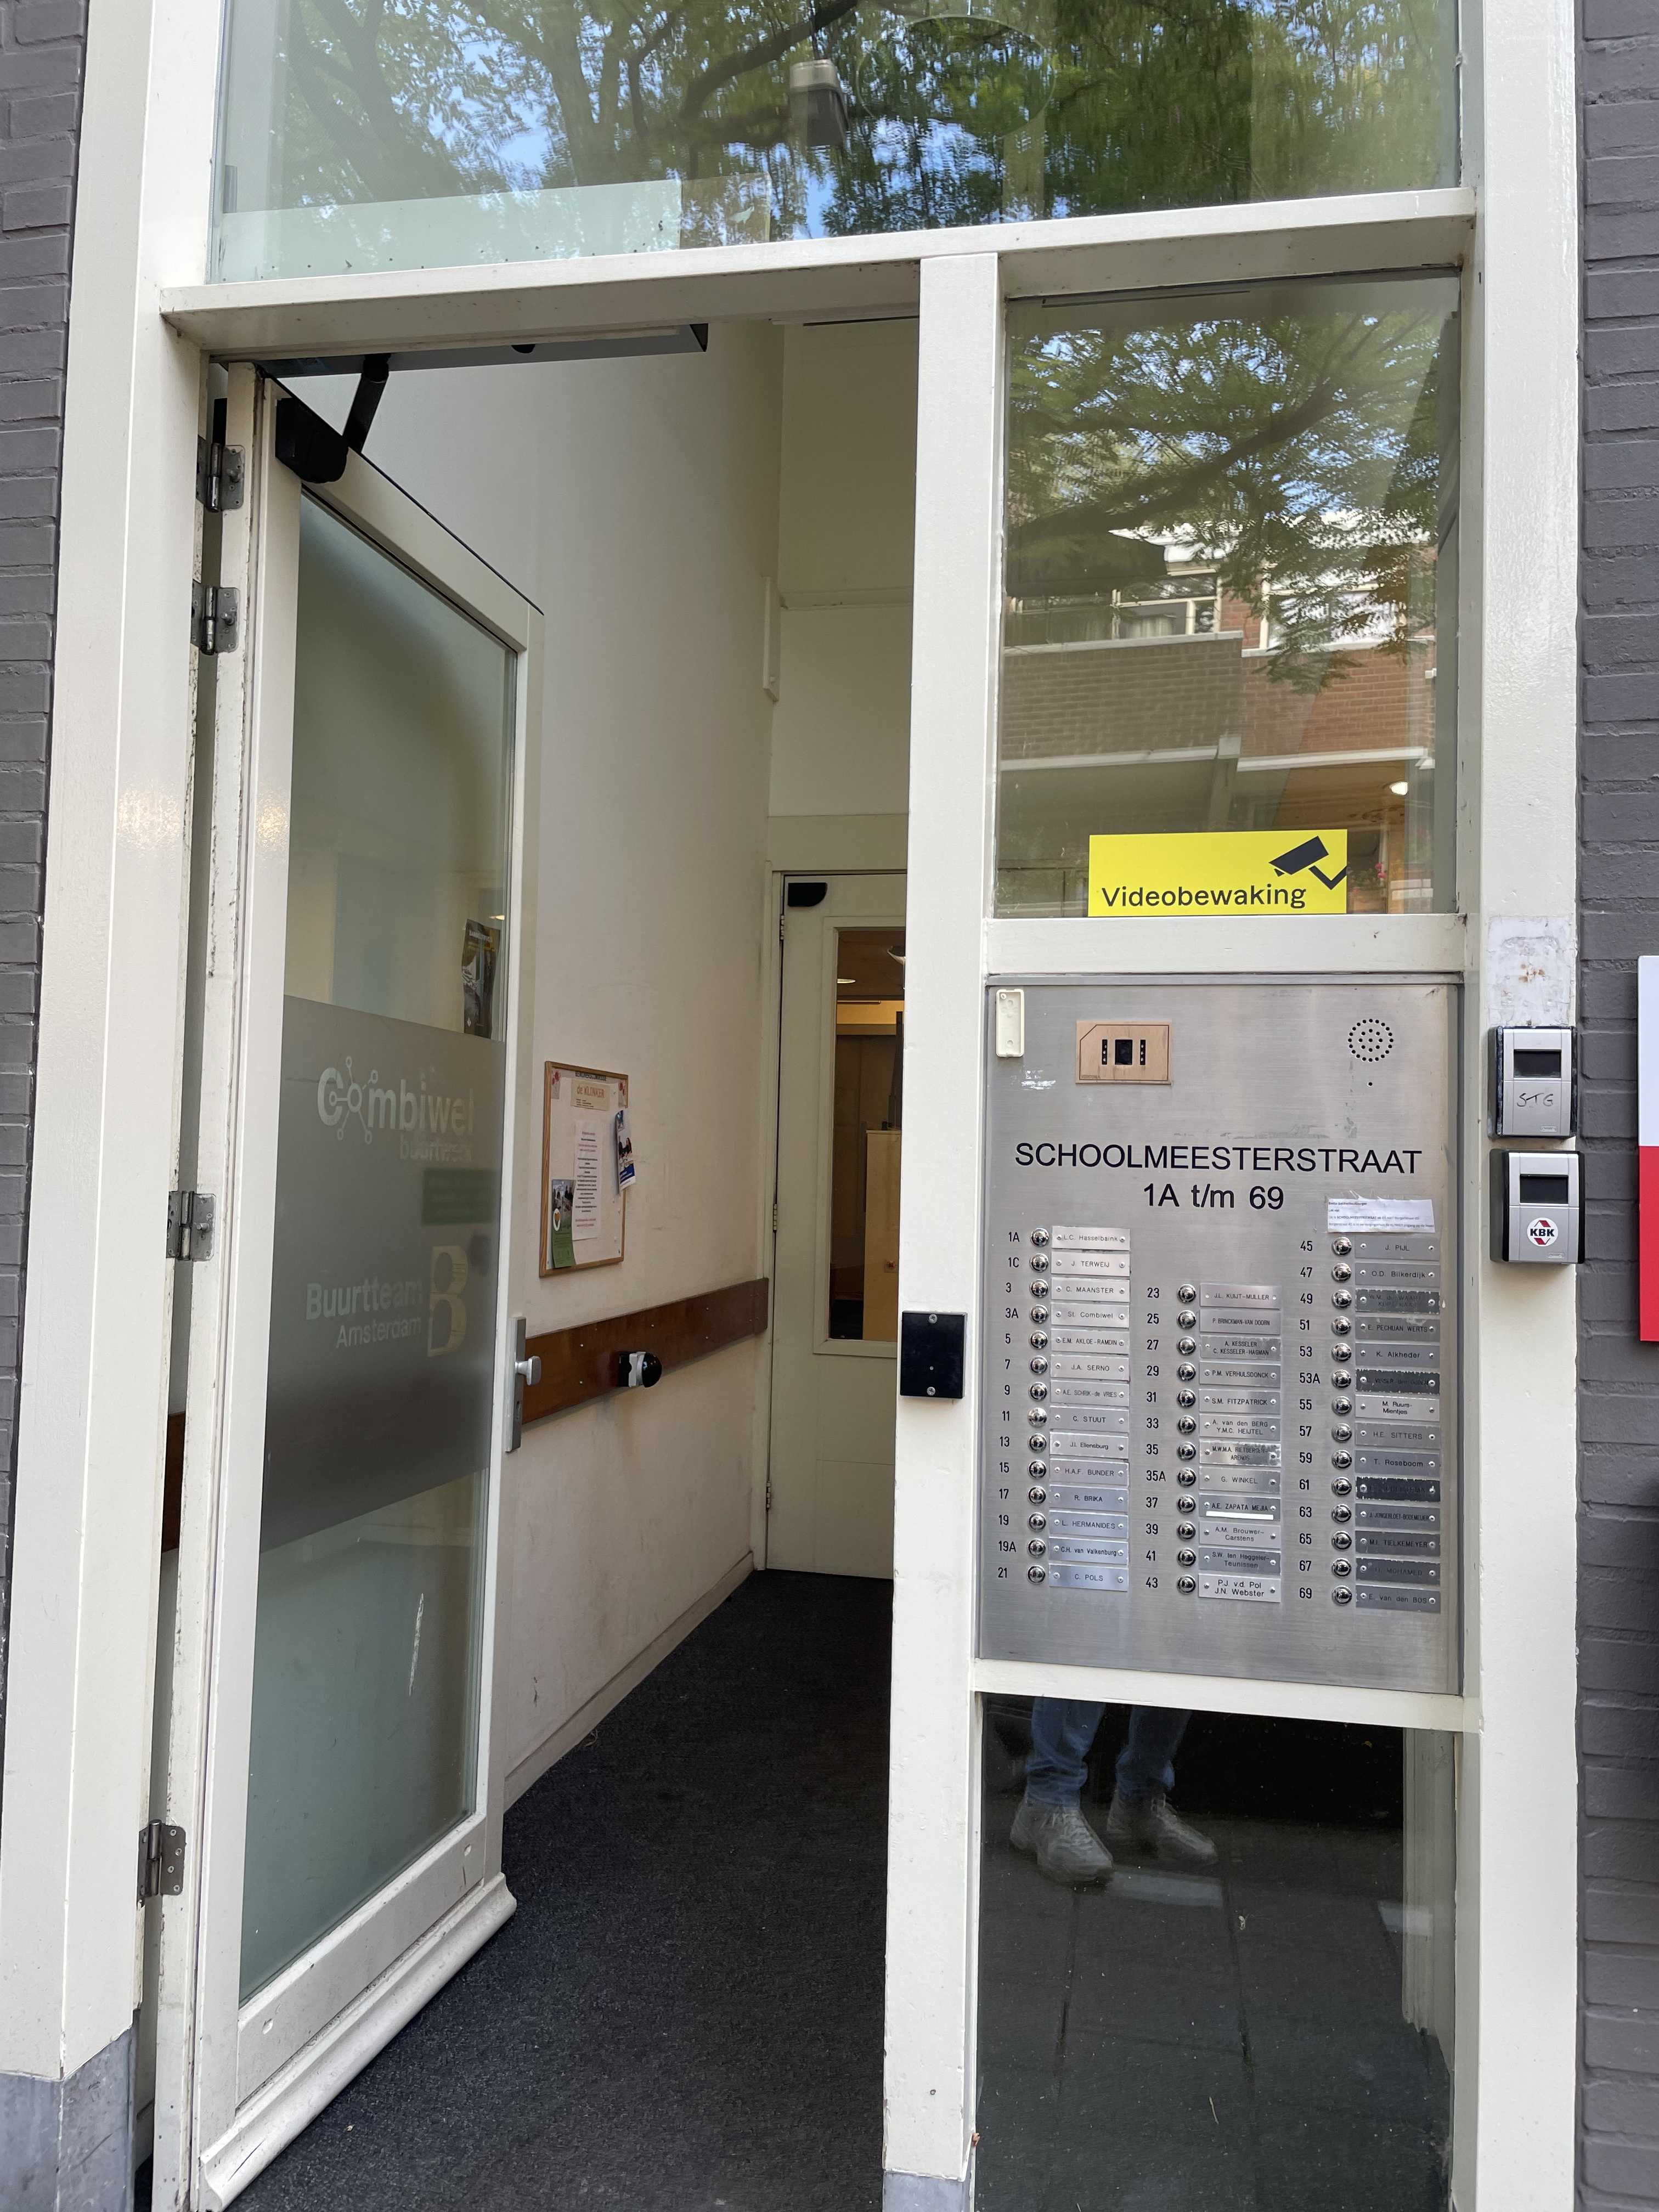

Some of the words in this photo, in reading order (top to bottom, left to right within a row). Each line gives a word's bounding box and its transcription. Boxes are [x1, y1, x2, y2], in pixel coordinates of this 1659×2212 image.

[1102, 883, 1306, 909] Videobewaking
[1516, 1092, 1554, 1107] STG
[1015, 1143, 1422, 1174] SCHOOLMEESTERSTRAAT
[1143, 1183, 1180, 1207] 1A
[1191, 1184, 1234, 1209] t/m
[1250, 1186, 1284, 1210] 69
[1008, 1232, 1020, 1242] 1A
[1530, 1228, 1555, 1237] KBK
[1300, 1240, 1313, 1251] 45
[1008, 1257, 1019, 1267] 1C
[1300, 1267, 1313, 1278] 47
[1006, 1282, 1011, 1293] 3
[1147, 1287, 1160, 1298] 23
[306, 1276, 424, 1320] Buurtteam
[1300, 1293, 1313, 1304] 49
[1006, 1308, 1019, 1318] 3A
[1147, 1313, 1159, 1324] 25
[1300, 1319, 1310, 1330] 51
[336, 1315, 421, 1348] Amsterdam
[1005, 1334, 1011, 1344] 5
[1147, 1339, 1159, 1350] 27
[1300, 1346, 1312, 1357] 53
[1005, 1359, 1011, 1369] 7
[1147, 1365, 1159, 1376] 29
[1300, 1373, 1321, 1384] 53A
[1005, 1385, 1010, 1395] 9
[1146, 1391, 1156, 1402] 31
[1300, 1399, 1312, 1410] 55
[1002, 1410, 1010, 1421] 11
[1146, 1418, 1159, 1429] 33
[1300, 1426, 1312, 1437] 57
[1000, 1436, 1010, 1447] 13
[1146, 1444, 1159, 1455] 35
[1300, 1452, 1312, 1464] 59
[1385, 1459, 1423, 1468] Roseboom
[1000, 1462, 1009, 1473] 15
[1146, 1470, 1166, 1481] 35A
[1300, 1479, 1310, 1490] 61
[999, 1488, 1009, 1499] 17
[1146, 1497, 1158, 1508] 37
[1299, 1506, 1312, 1517] 63
[998, 1515, 1009, 1526] 19
[1146, 1523, 1159, 1534] 39
[1299, 1533, 1312, 1544] 65
[998, 1541, 1017, 1553] 19A
[1087, 1549, 1117, 1557] Valkenburg
[1146, 1550, 1156, 1561] 41
[1224, 1560, 1259, 1568] Teunissen
[1299, 1560, 1312, 1571] 67
[998, 1567, 1007, 1578] 21
[1146, 1577, 1158, 1588] 43
[1232, 1588, 1265, 1597] Webster
[1299, 1588, 1312, 1599] 69
